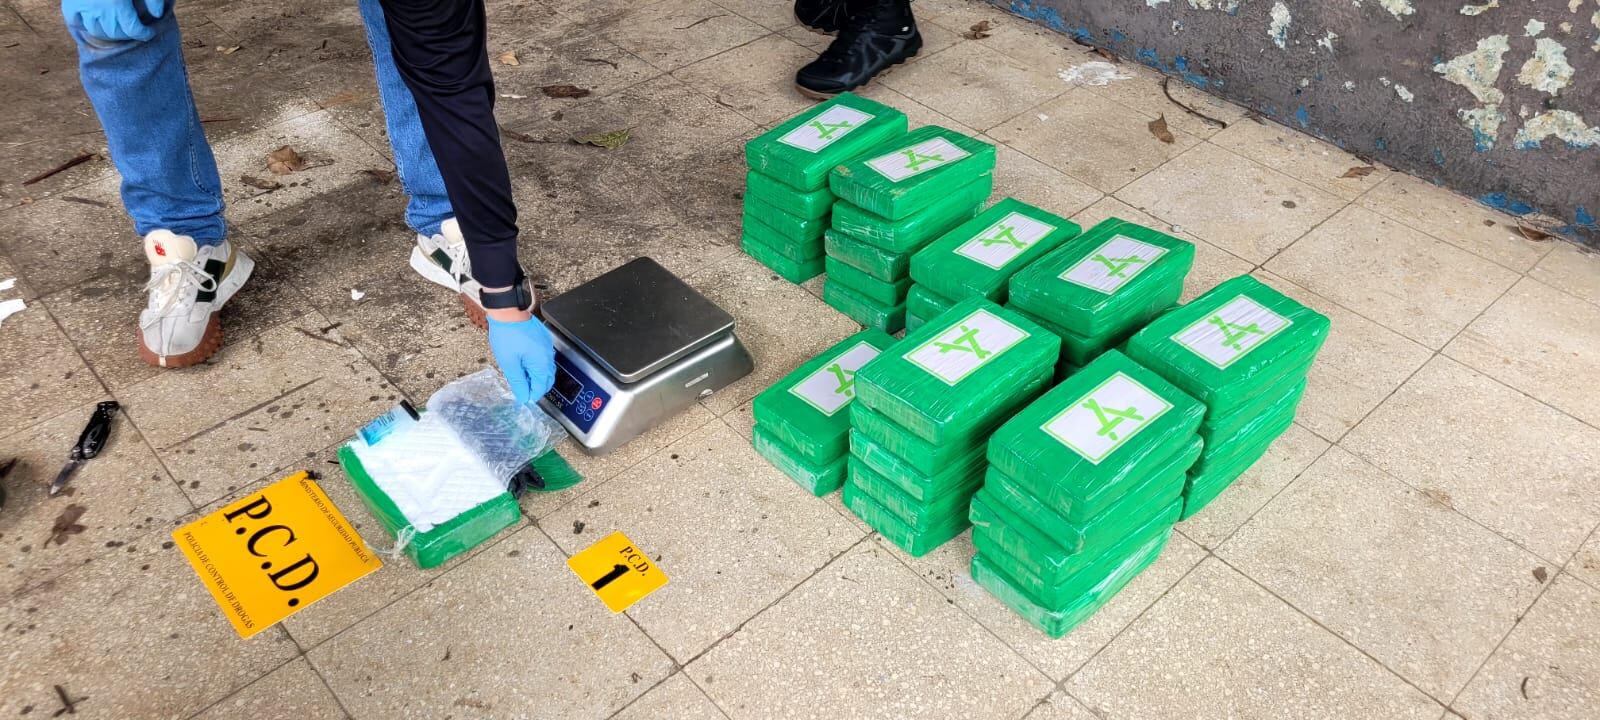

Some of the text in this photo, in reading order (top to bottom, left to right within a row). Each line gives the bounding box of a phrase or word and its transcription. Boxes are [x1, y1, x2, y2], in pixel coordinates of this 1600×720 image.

[197, 553, 210, 566] DE
[223, 495, 319, 607] P.C.D.
[619, 546, 649, 577] P.C.D.
[203, 562, 230, 594] CONTROL
[591, 564, 630, 591] 1
[224, 591, 238, 605] DE
[230, 601, 255, 630] DROGAS
